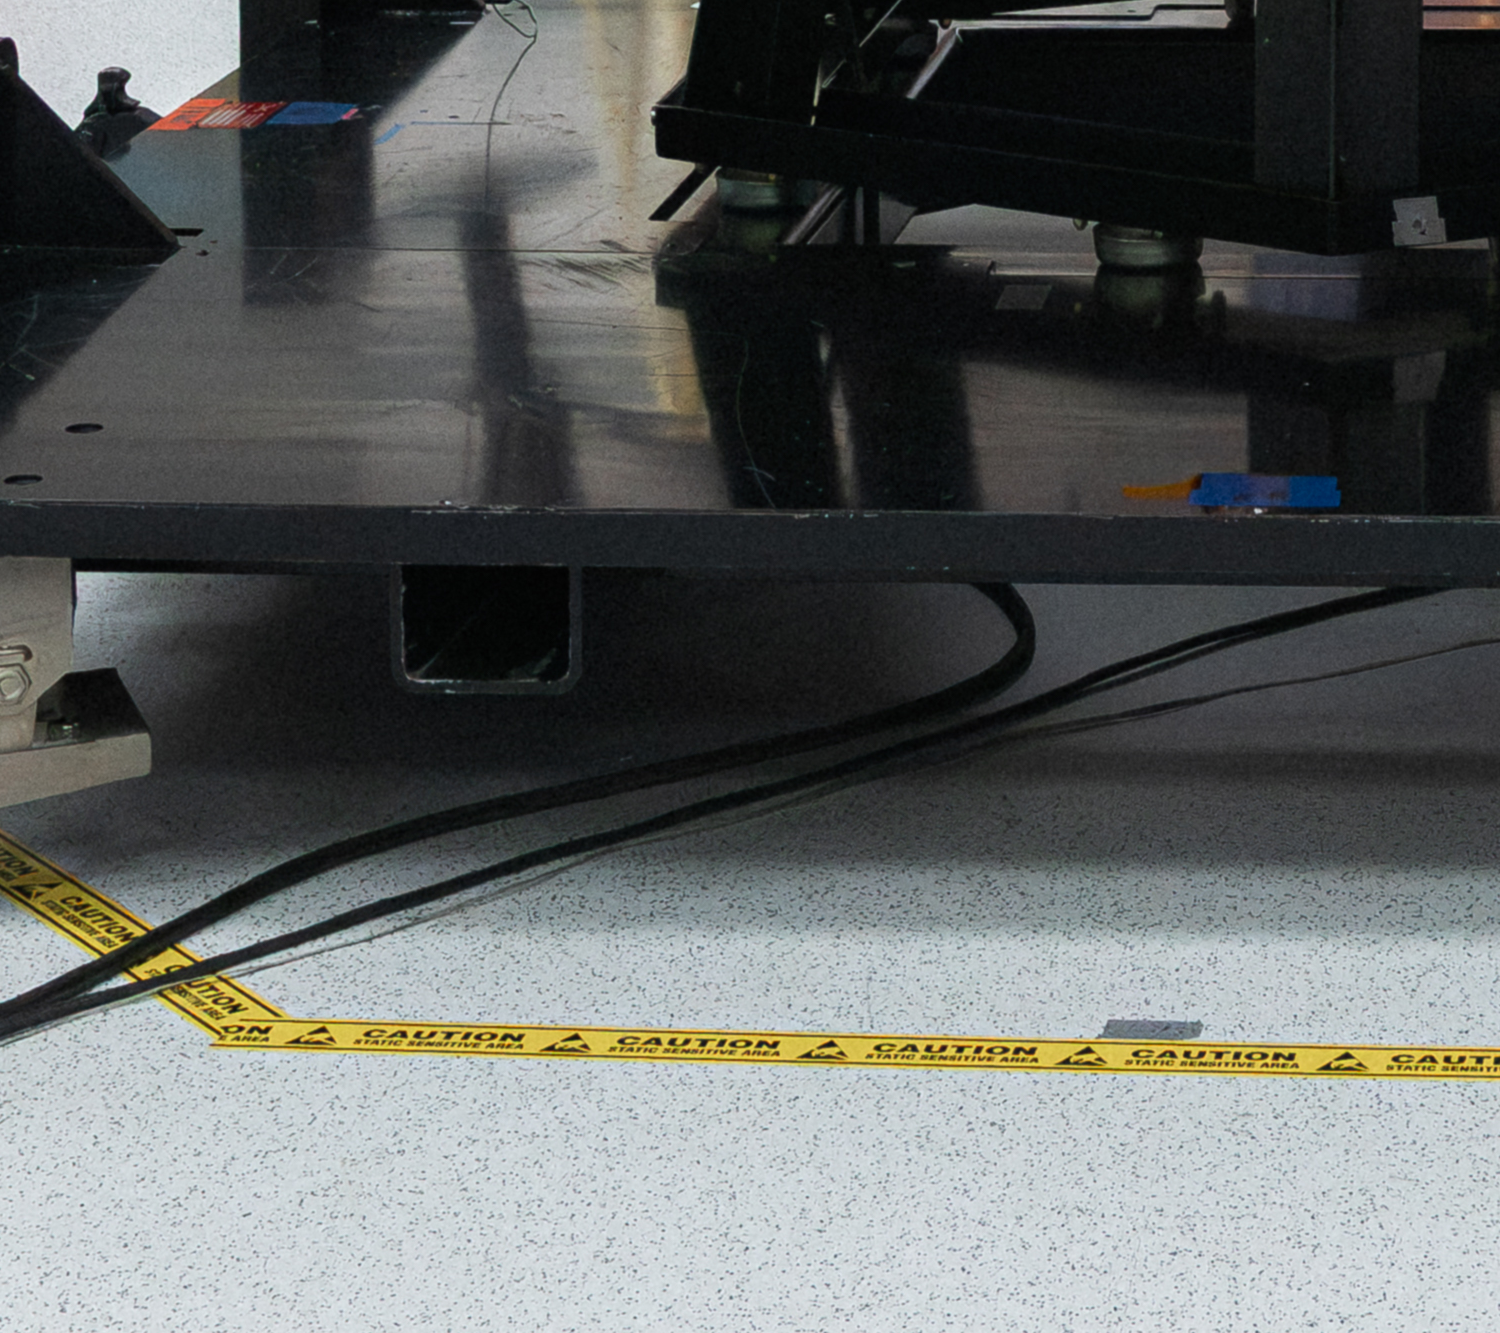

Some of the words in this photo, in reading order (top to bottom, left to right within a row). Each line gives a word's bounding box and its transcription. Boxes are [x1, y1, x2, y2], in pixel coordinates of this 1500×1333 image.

[60, 896, 139, 942] CAUTION
[363, 1029, 526, 1042] CAUTION
[353, 1038, 402, 1046] STATIC
[407, 1040, 482, 1049] SENSITIVE
[485, 1042, 525, 1050] AREA
[616, 1036, 781, 1049] CAUTION
[662, 1047, 738, 1056] SENSITIVE
[741, 1049, 781, 1057] AREA
[872, 1043, 1038, 1055] CAUTION
[1131, 1049, 1297, 1061] CAUTION
[920, 1054, 997, 1062] SENSITIVE
[1179, 1060, 1256, 1068] SENSITIVE
[1386, 1064, 1437, 1072] STATIC
